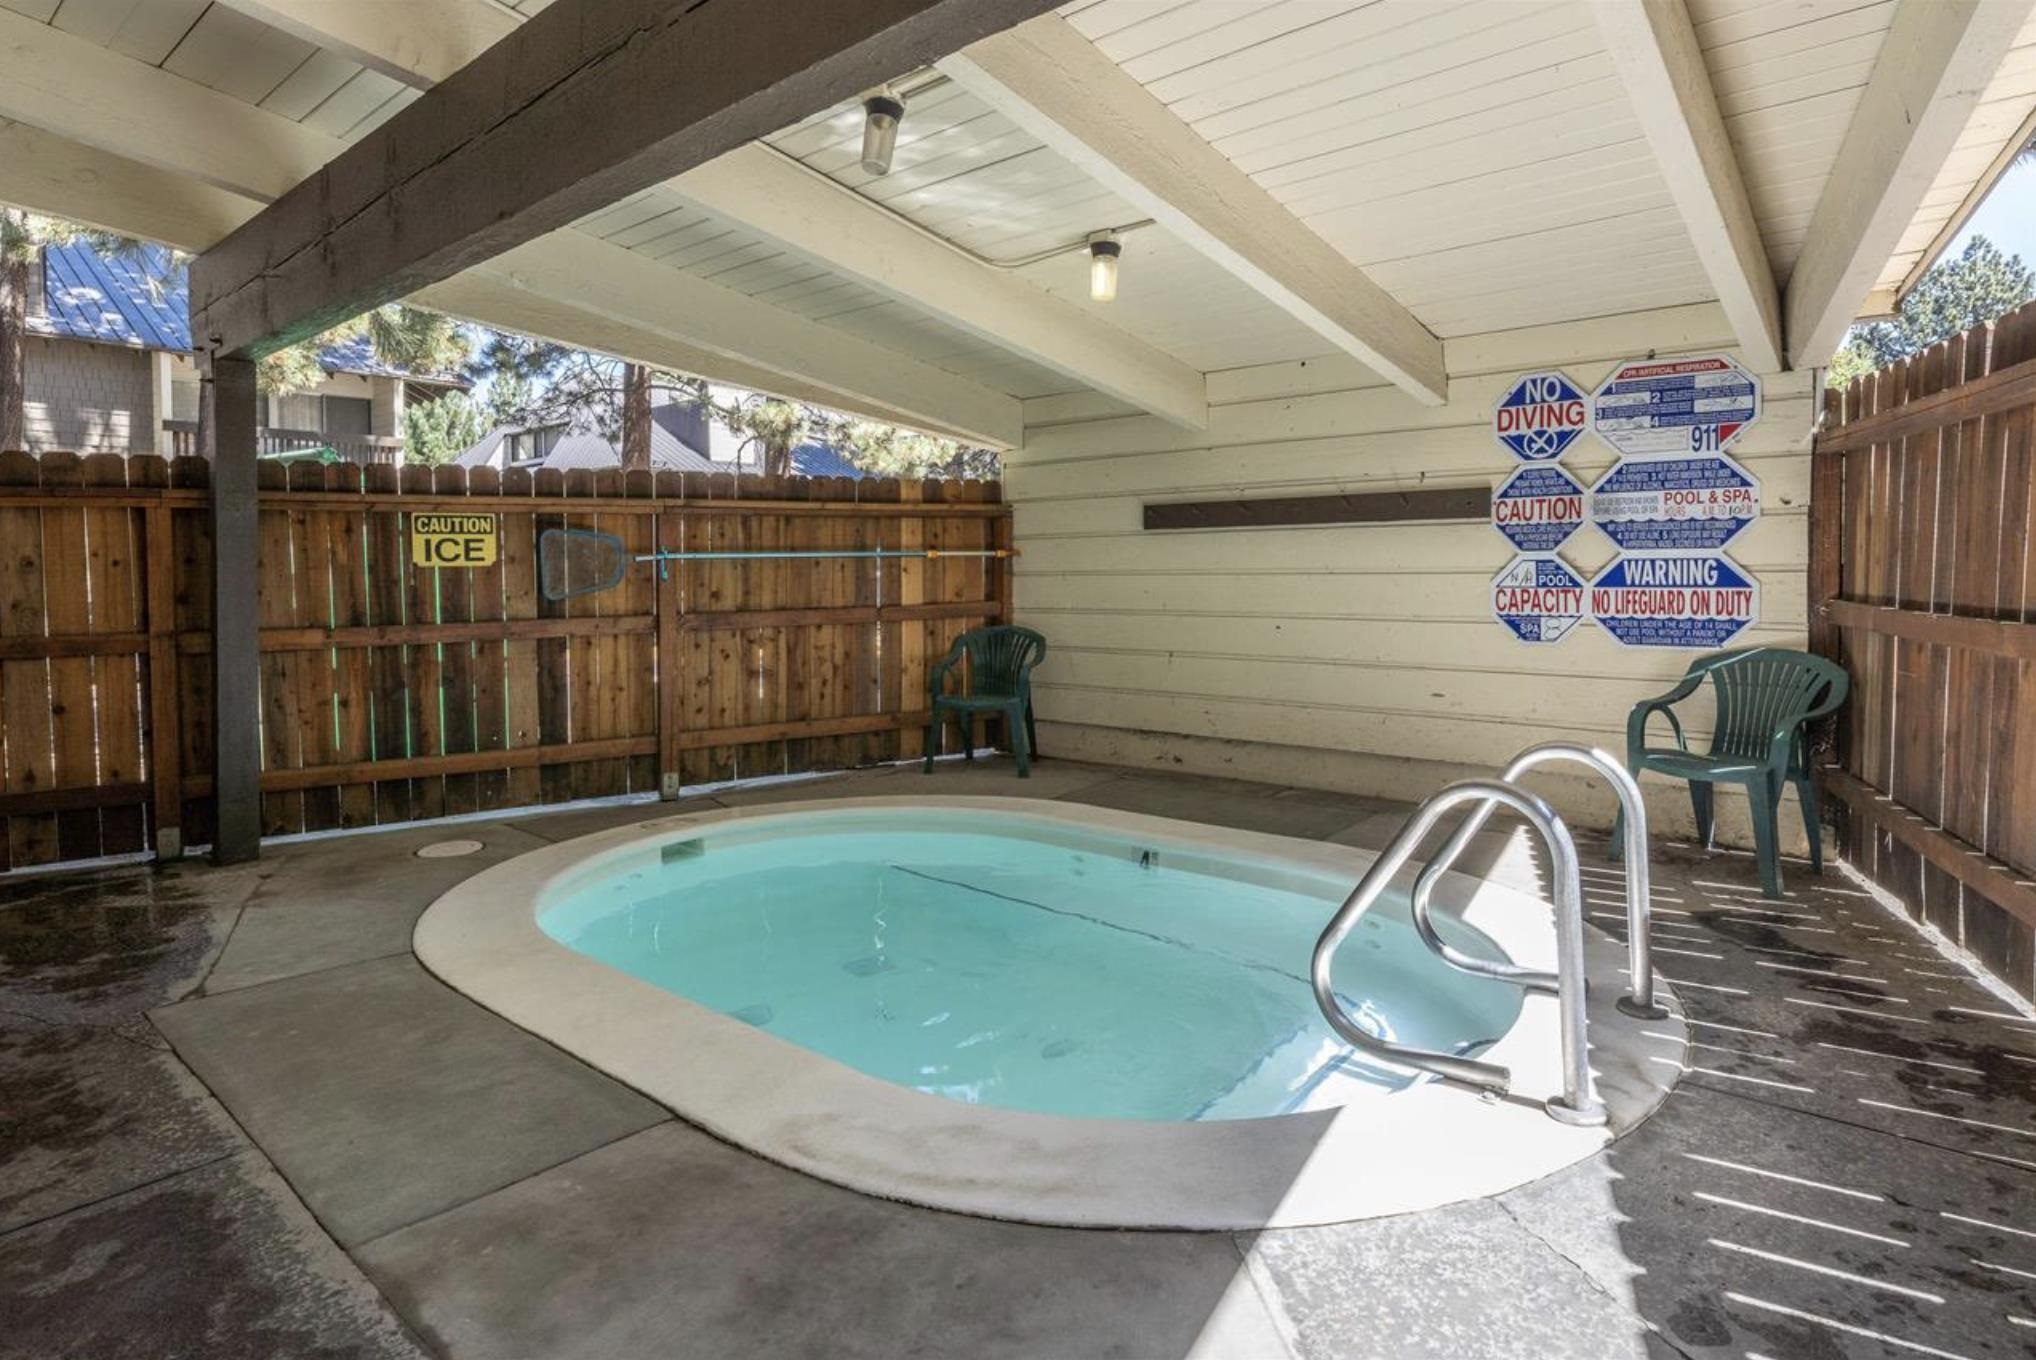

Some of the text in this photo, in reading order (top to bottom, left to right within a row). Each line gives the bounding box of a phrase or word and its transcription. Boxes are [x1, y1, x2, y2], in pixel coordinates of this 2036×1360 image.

[1675, 360, 1722, 373] RESPIRATION
[1525, 377, 1561, 404] NO
[1651, 391, 1662, 403] 2
[1497, 401, 1584, 432] DIVING
[1691, 425, 1720, 453] 911
[1664, 490, 1706, 506] POOL
[1708, 490, 1719, 504] &
[1722, 488, 1752, 504] SPA
[1496, 497, 1582, 522] CAUTION
[416, 517, 492, 533] CAUTION
[424, 537, 486, 563] ICE
[1538, 575, 1573, 586] POOL
[1623, 559, 1719, 586] WARNING
[1495, 588, 1584, 614] CAPACITY
[1591, 589, 1753, 617] NO LIFEGUARD ON DUTY
[1520, 623, 1540, 634] SPA
[1605, 620, 1639, 628] CHILDREN
[1640, 620, 1663, 629] UNDER
[1664, 620, 1677, 629] THE
[1678, 620, 1692, 629] AGE
[1693, 621, 1703, 630] OF
[1715, 621, 1737, 630] SHALL
[1615, 628, 1628, 636] NOT
[1629, 628, 1640, 636] USE
[1658, 628, 1686, 637] WITHOUT
[1692, 629, 1715, 638] PARENT
[1716, 629, 1727, 638] OR
[1622, 636, 1641, 644] ADULT
[1642, 636, 1672, 645] GUARDIAN
